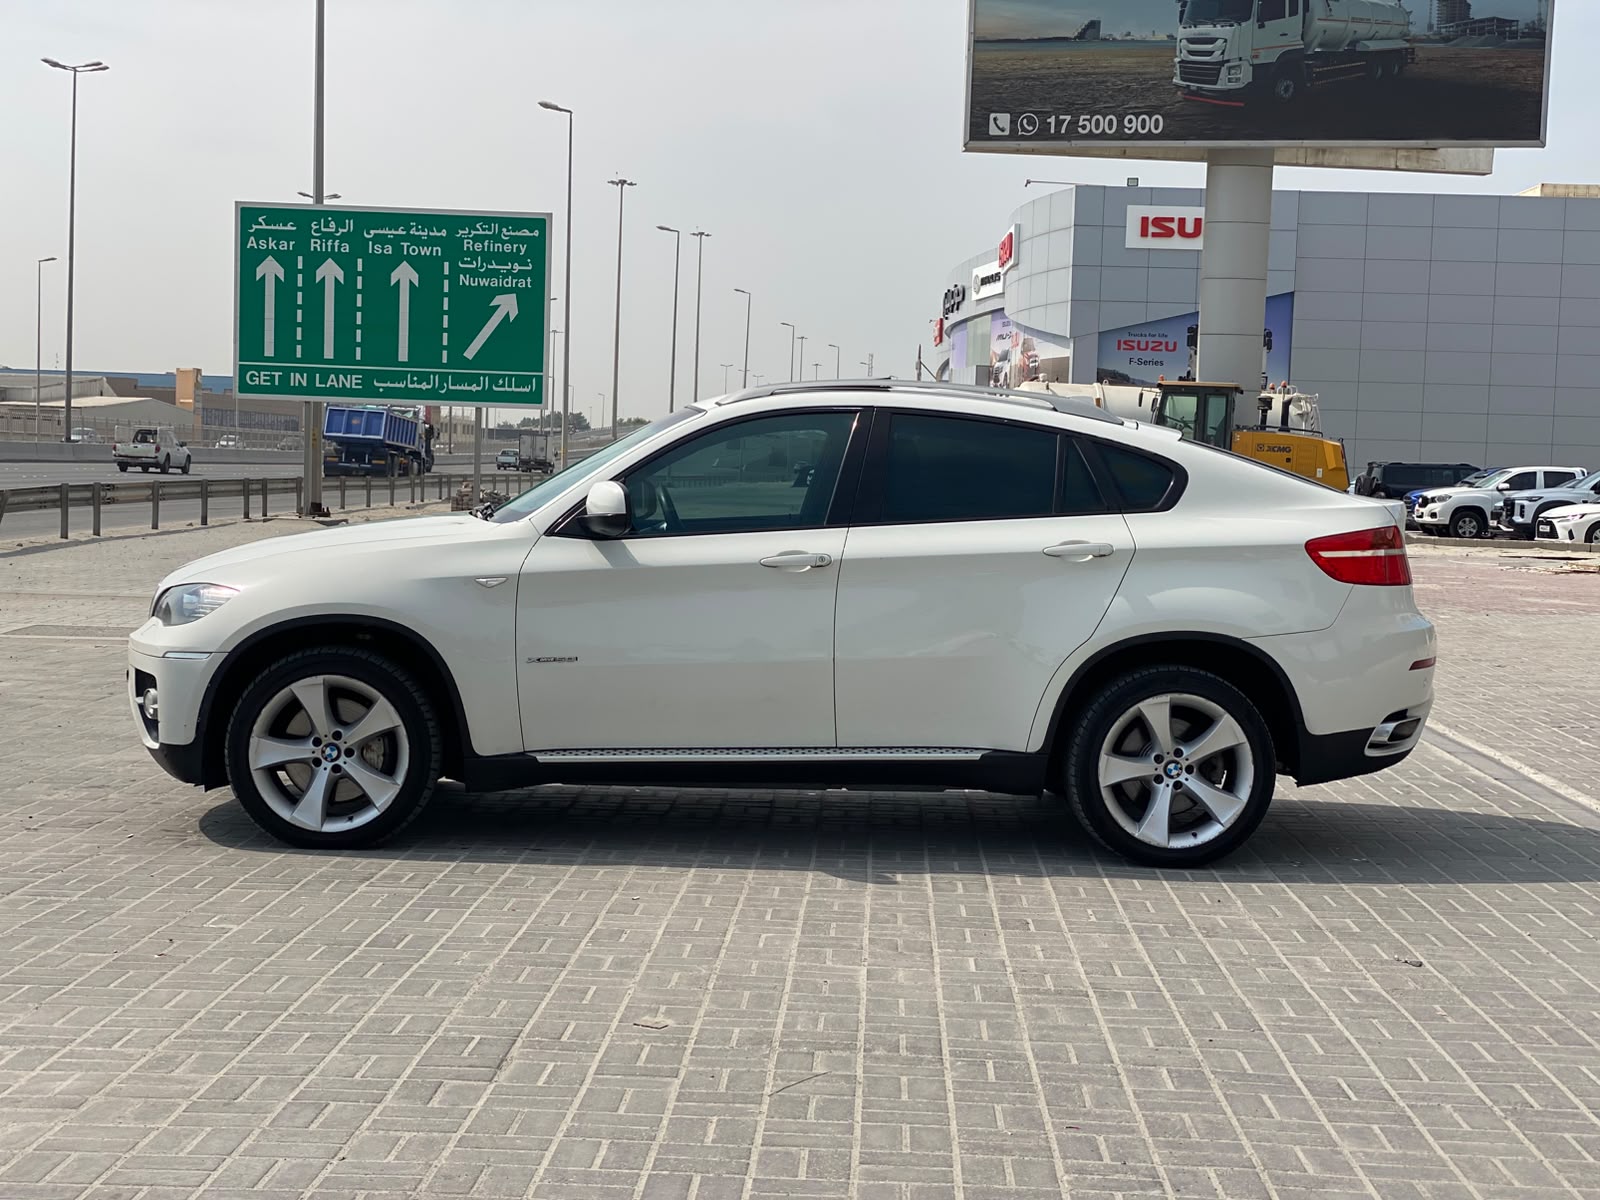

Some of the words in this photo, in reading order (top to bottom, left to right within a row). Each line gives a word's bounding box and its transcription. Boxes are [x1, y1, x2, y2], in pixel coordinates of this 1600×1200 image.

[1046, 115, 1072, 134] 17
[1077, 114, 1118, 134] 500
[1123, 114, 1164, 134] 900
[247, 215, 297, 232] عسكر
[310, 217, 354, 235] الرفاع
[409, 222, 447, 240] مدينة
[455, 222, 499, 238] التكرير
[1140, 216, 1203, 239] ISU
[363, 225, 407, 239] عيسى
[500, 226, 540, 240] مصنع
[246, 236, 296, 251] Askar
[310, 238, 350, 253] Riffa
[368, 241, 393, 255] Isa
[400, 242, 442, 257] Town
[463, 239, 528, 255] Refinery
[458, 256, 533, 273] نويدرات
[459, 274, 532, 288] Nuwaidrat
[1117, 339, 1177, 352] ISUZU
[1129, 358, 1164, 366] F-Series
[245, 370, 283, 386] GET
[290, 372, 307, 387] IN
[315, 373, 363, 389] LANE
[373, 372, 439, 392] المناسب
[439, 374, 489, 394] المسار
[492, 376, 536, 393] اسلك
